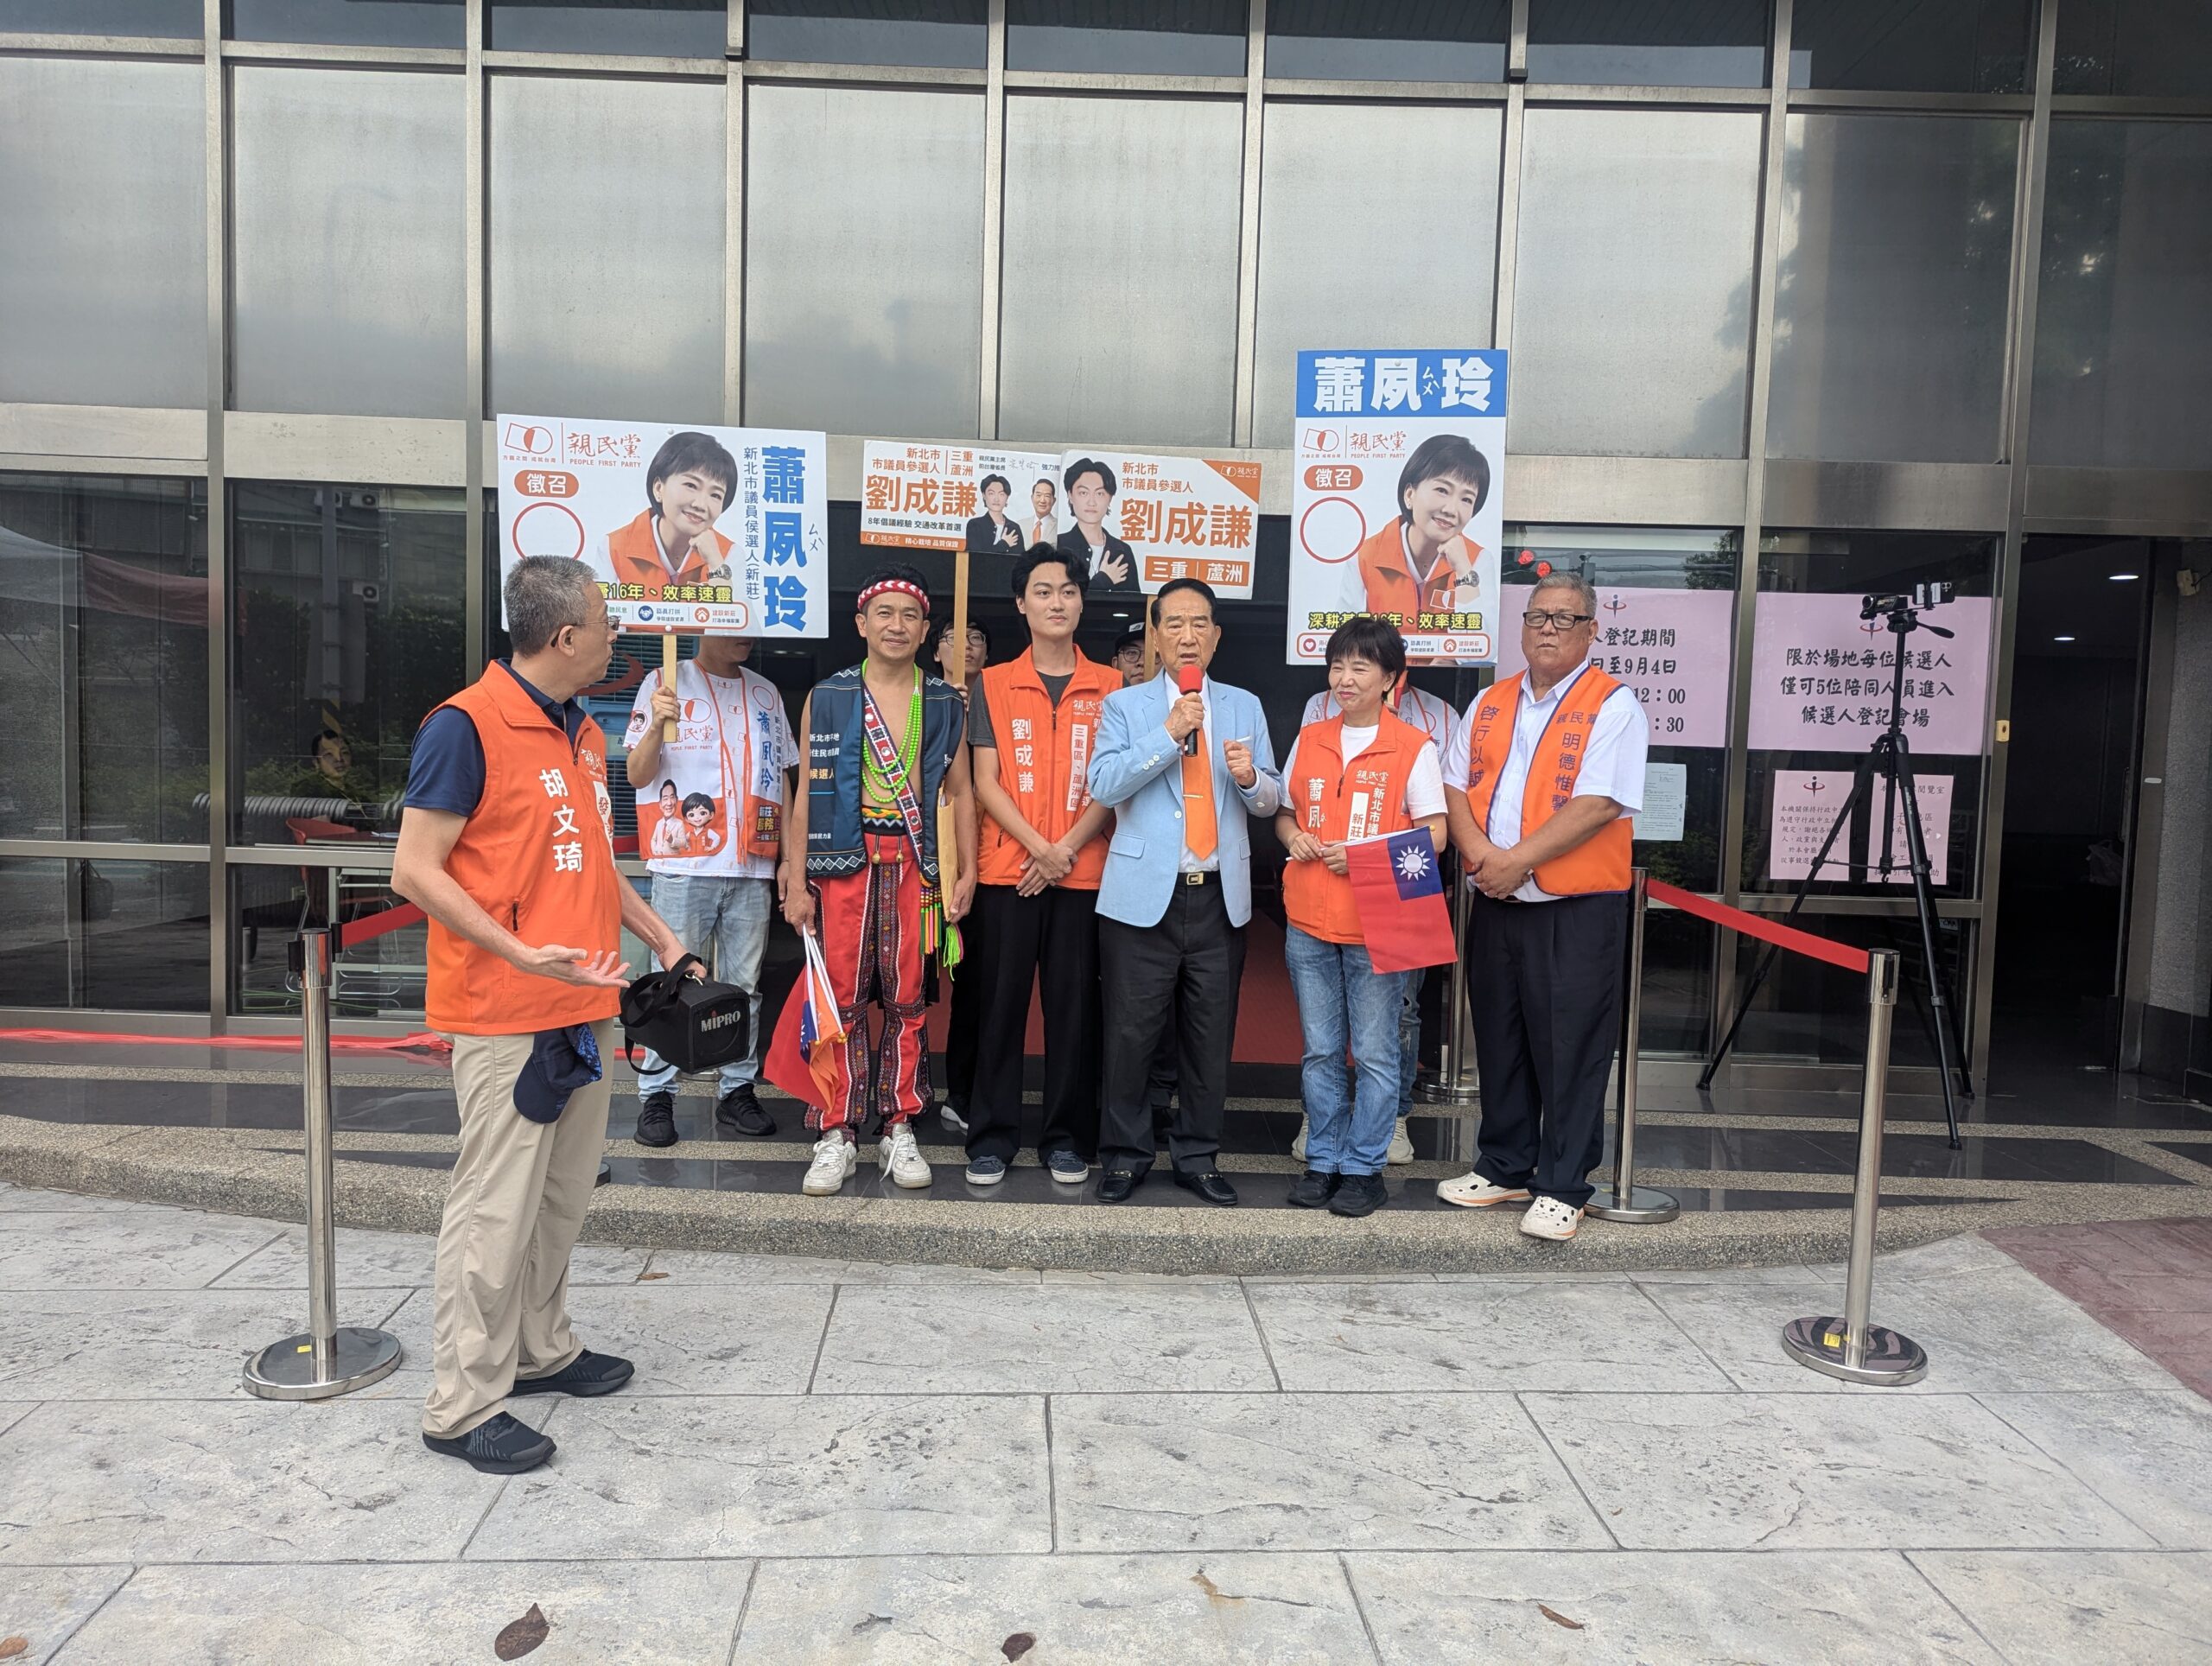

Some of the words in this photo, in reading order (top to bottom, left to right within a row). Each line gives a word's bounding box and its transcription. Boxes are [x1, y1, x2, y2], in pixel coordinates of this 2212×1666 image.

[567, 432, 641, 459] 親民黨
[1350, 430, 1407, 452] 親民黨
[906, 448, 940, 461] 新北市
[950, 450, 974, 462] 三重
[872, 458, 940, 474] 市議員參選人
[950, 464, 973, 477] 蘆洲
[1122, 461, 1159, 476] 新北市
[526, 473, 567, 495] 徵召
[1122, 477, 1194, 493] 市議員參選人
[1315, 467, 1352, 488] 徵召
[865, 474, 977, 518] 劉成謙
[914, 520, 962, 531] 交通改革首選
[1120, 498, 1252, 549] 劉成謙
[1152, 561, 1188, 580] 三重
[1206, 563, 1243, 583] 蘆洲
[1781, 676, 1955, 698] 僅可5位陪同人員進入
[1011, 718, 1034, 793] 劉成謙
[539, 767, 584, 874] 胡文琦
[1307, 778, 1325, 844] 蕭夙
[1367, 787, 1386, 837] 新北市議
[1350, 812, 1364, 842] 新莊
[701, 1010, 741, 1033] MIPRO
